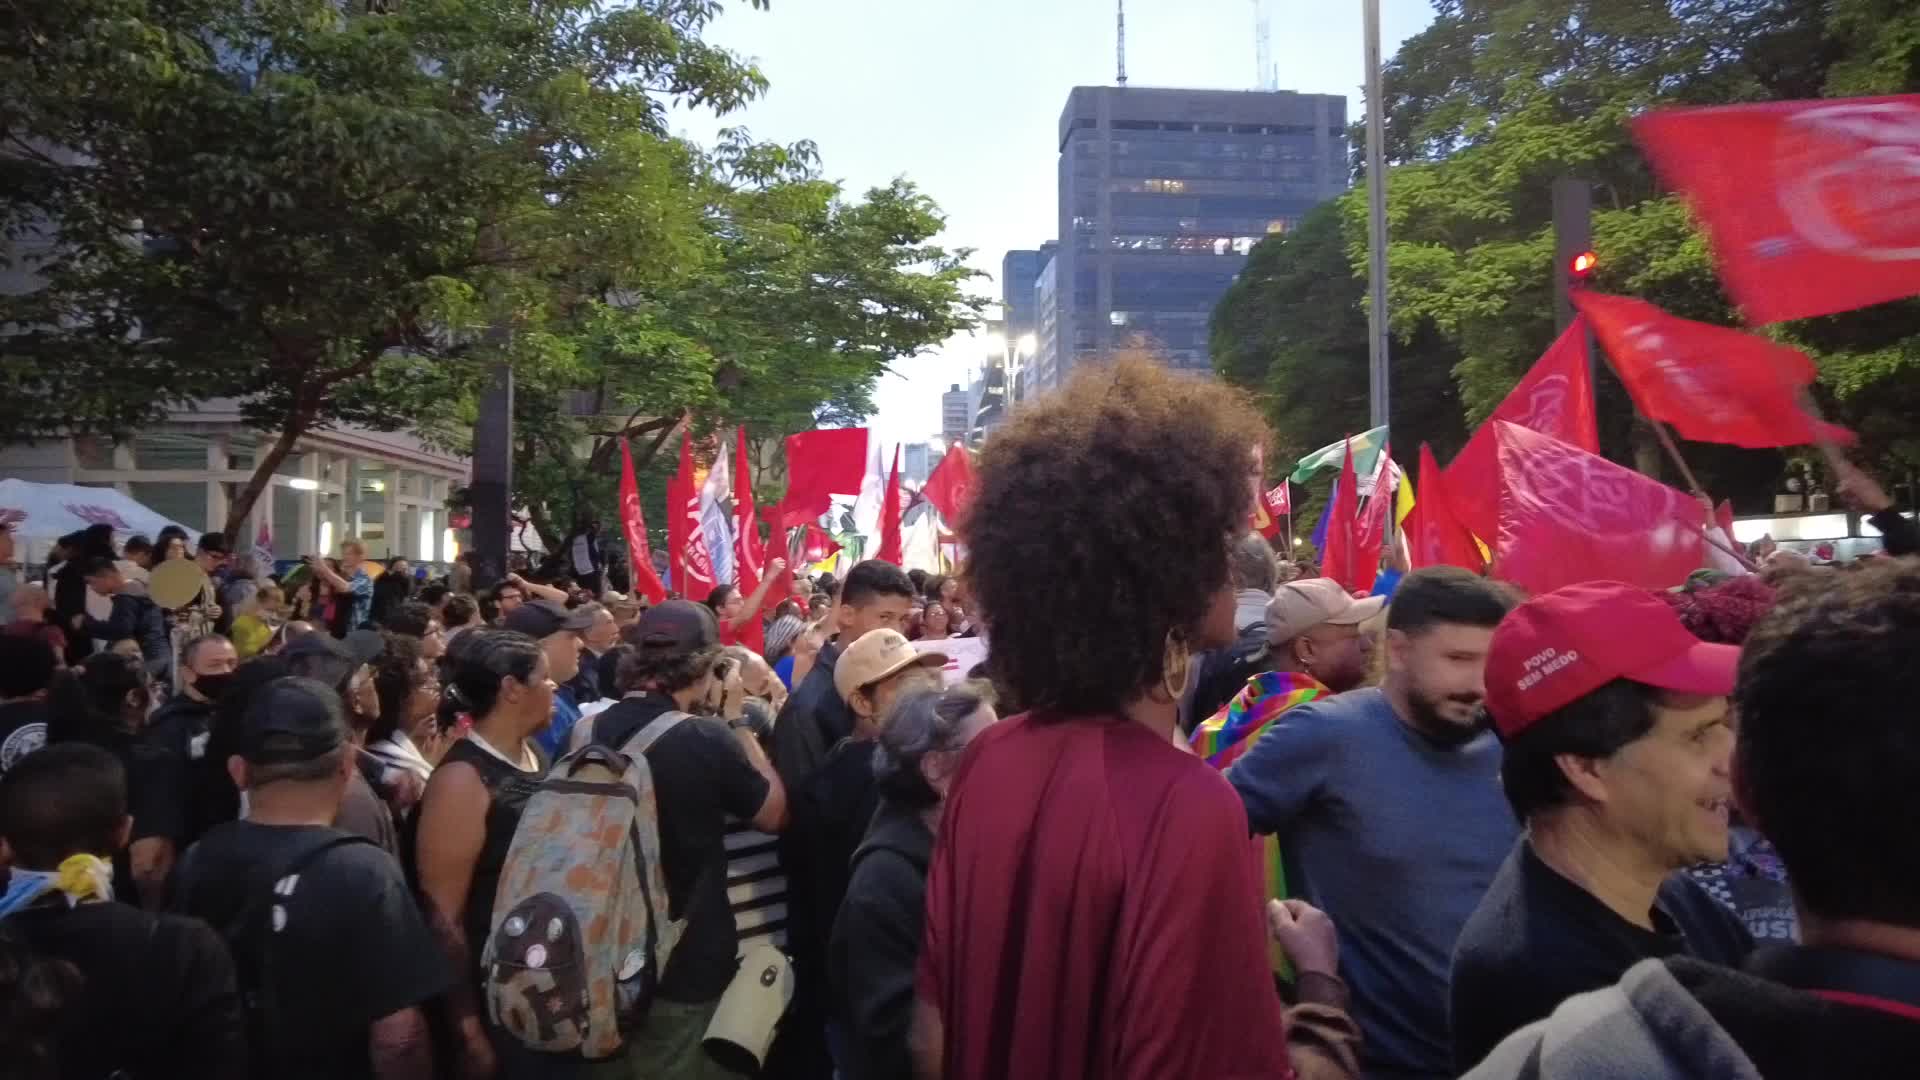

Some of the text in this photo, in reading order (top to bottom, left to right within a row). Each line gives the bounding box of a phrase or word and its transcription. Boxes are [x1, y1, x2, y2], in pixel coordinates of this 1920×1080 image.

[1517, 650, 1578, 690] SEM MEDO
[1523, 647, 1557, 670] POVO
